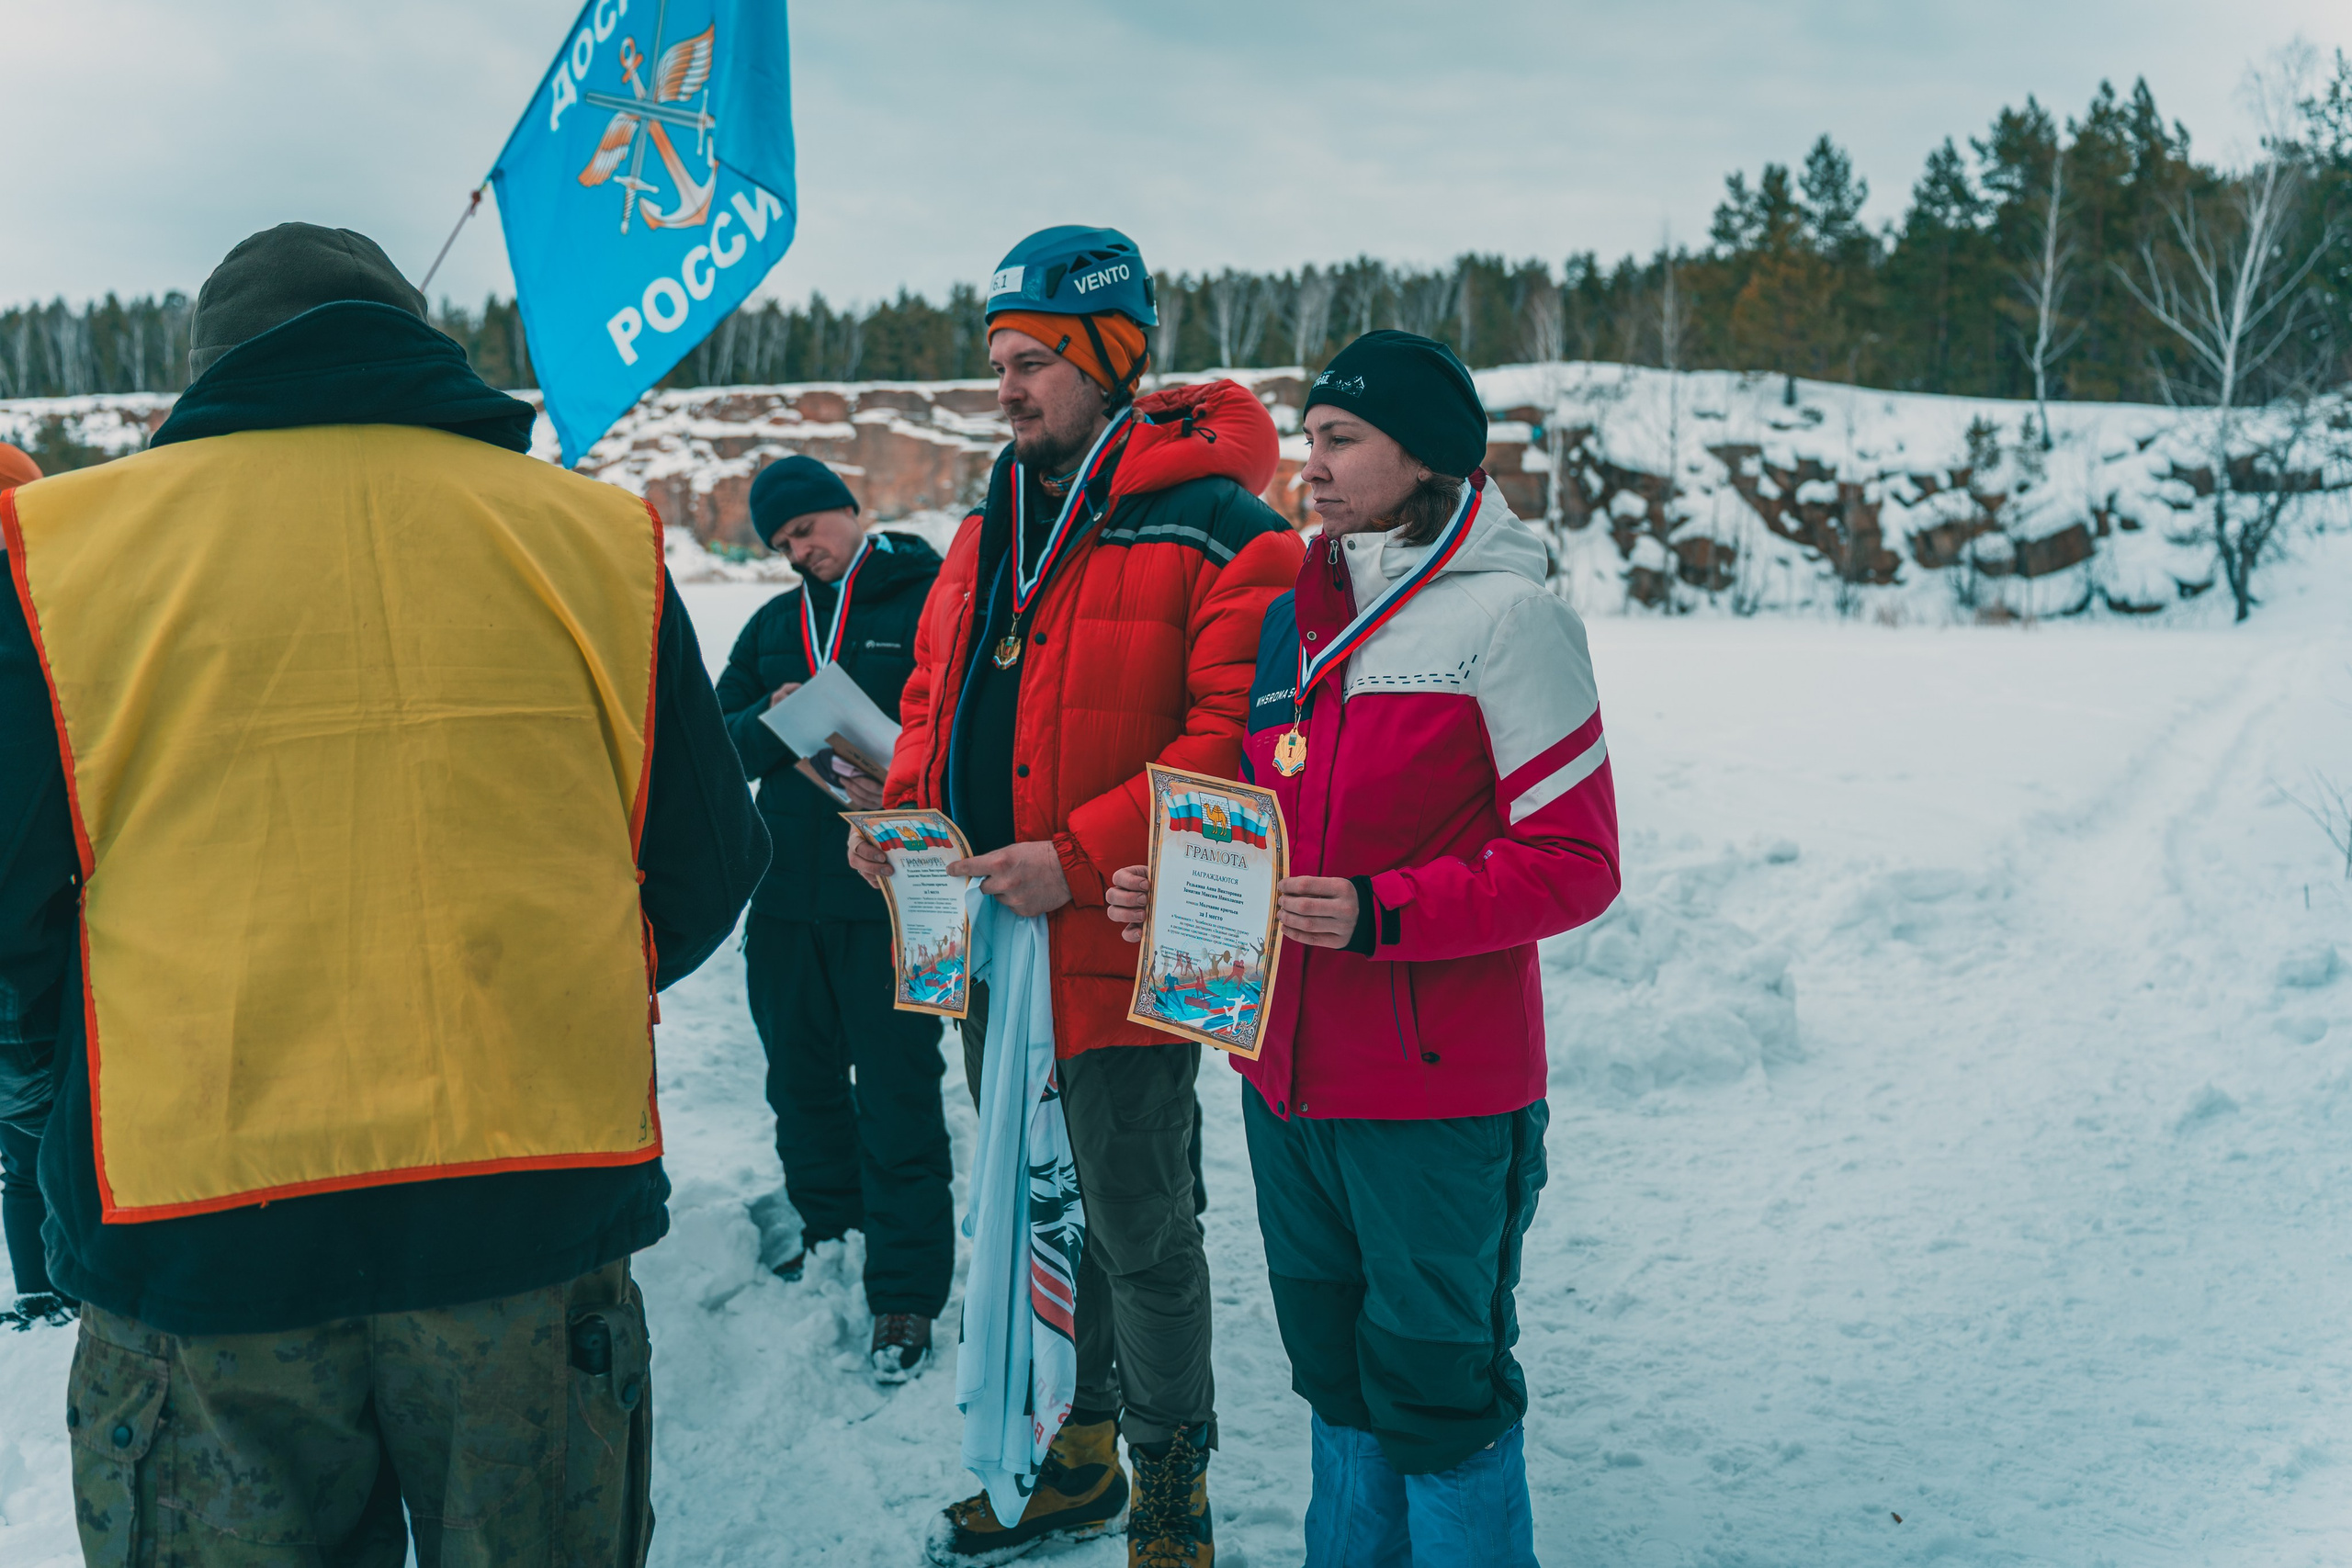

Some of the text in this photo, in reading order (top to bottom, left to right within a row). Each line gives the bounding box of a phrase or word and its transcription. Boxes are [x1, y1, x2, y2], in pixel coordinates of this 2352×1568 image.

[549, 0, 628, 132] ДОС
[1073, 264, 1130, 295] VENTO
[1288, 747, 1294, 759] 1
[1185, 844, 1248, 869] ГРАМОТА
[1193, 870, 1238, 886] НАГРАЖДАЮТСЯ
